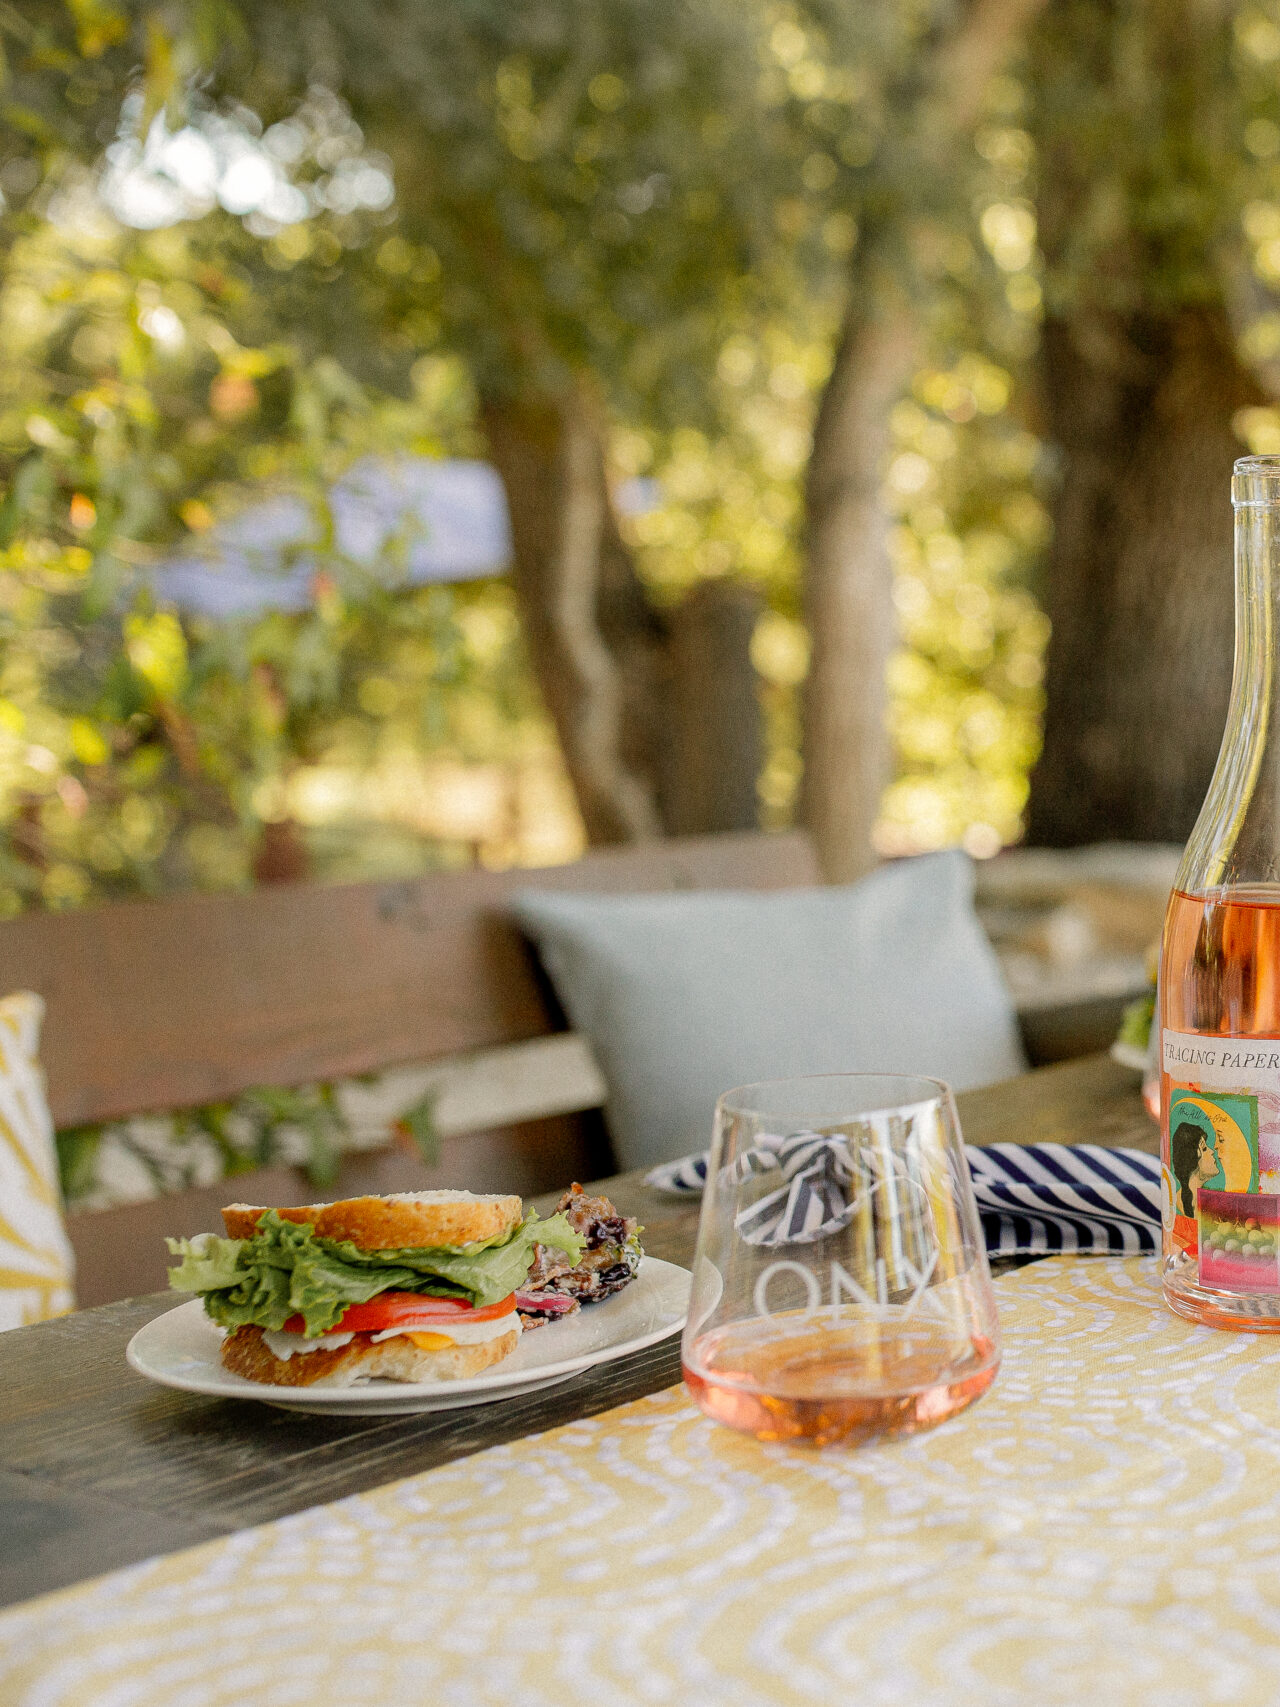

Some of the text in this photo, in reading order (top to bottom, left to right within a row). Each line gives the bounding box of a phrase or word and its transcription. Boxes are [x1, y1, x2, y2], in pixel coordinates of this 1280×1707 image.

[1164, 1042, 1280, 1069] TRACING PAPER
[753, 1250, 949, 1327] ONX
